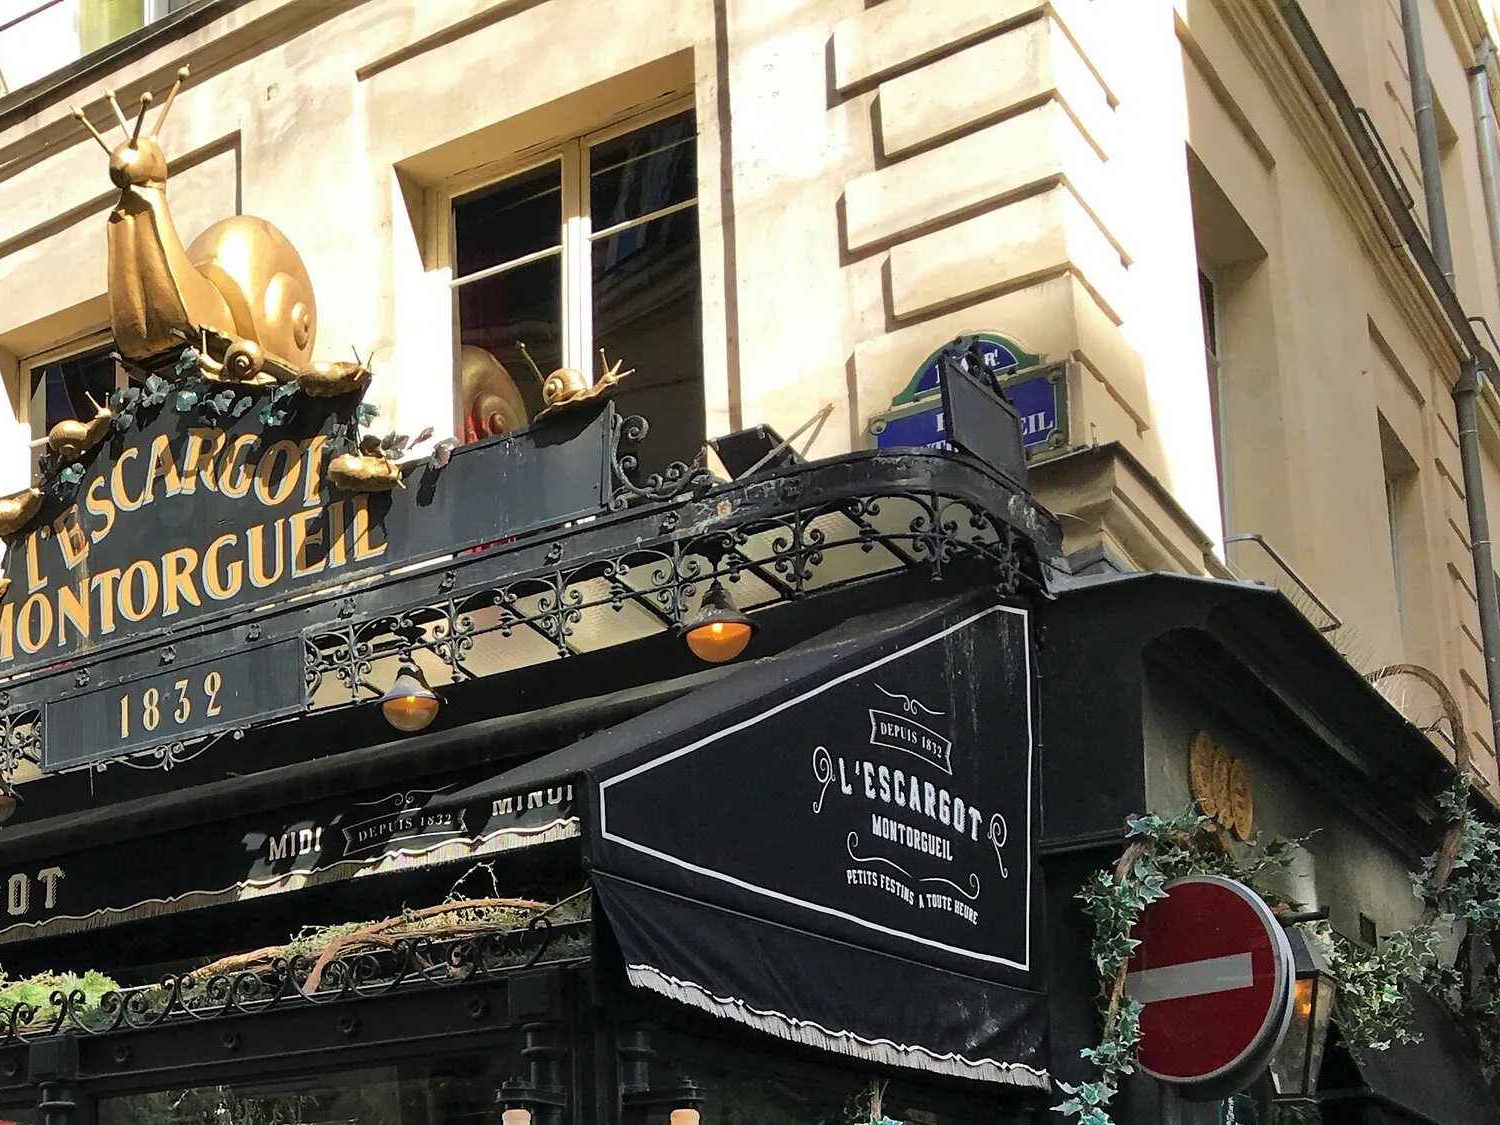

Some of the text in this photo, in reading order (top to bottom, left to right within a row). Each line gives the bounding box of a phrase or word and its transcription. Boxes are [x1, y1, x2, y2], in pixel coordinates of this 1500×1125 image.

[24, 426, 333, 594] L'ESCARGOT
[118, 670, 224, 740] 1832
[880, 722, 943, 759] DEPUIS 1832
[838, 757, 983, 842] L'ESCARGOT
[267, 827, 324, 862] MIDI
[357, 816, 413, 843] DEPUIS
[419, 812, 453, 828] 1832
[872, 813, 953, 862] MONTORGUEIL
[846, 869, 878, 887] PETITS
[880, 874, 915, 906] FESTINS
[926, 893, 953, 911] TOUTE
[954, 899, 979, 926] HEURE
